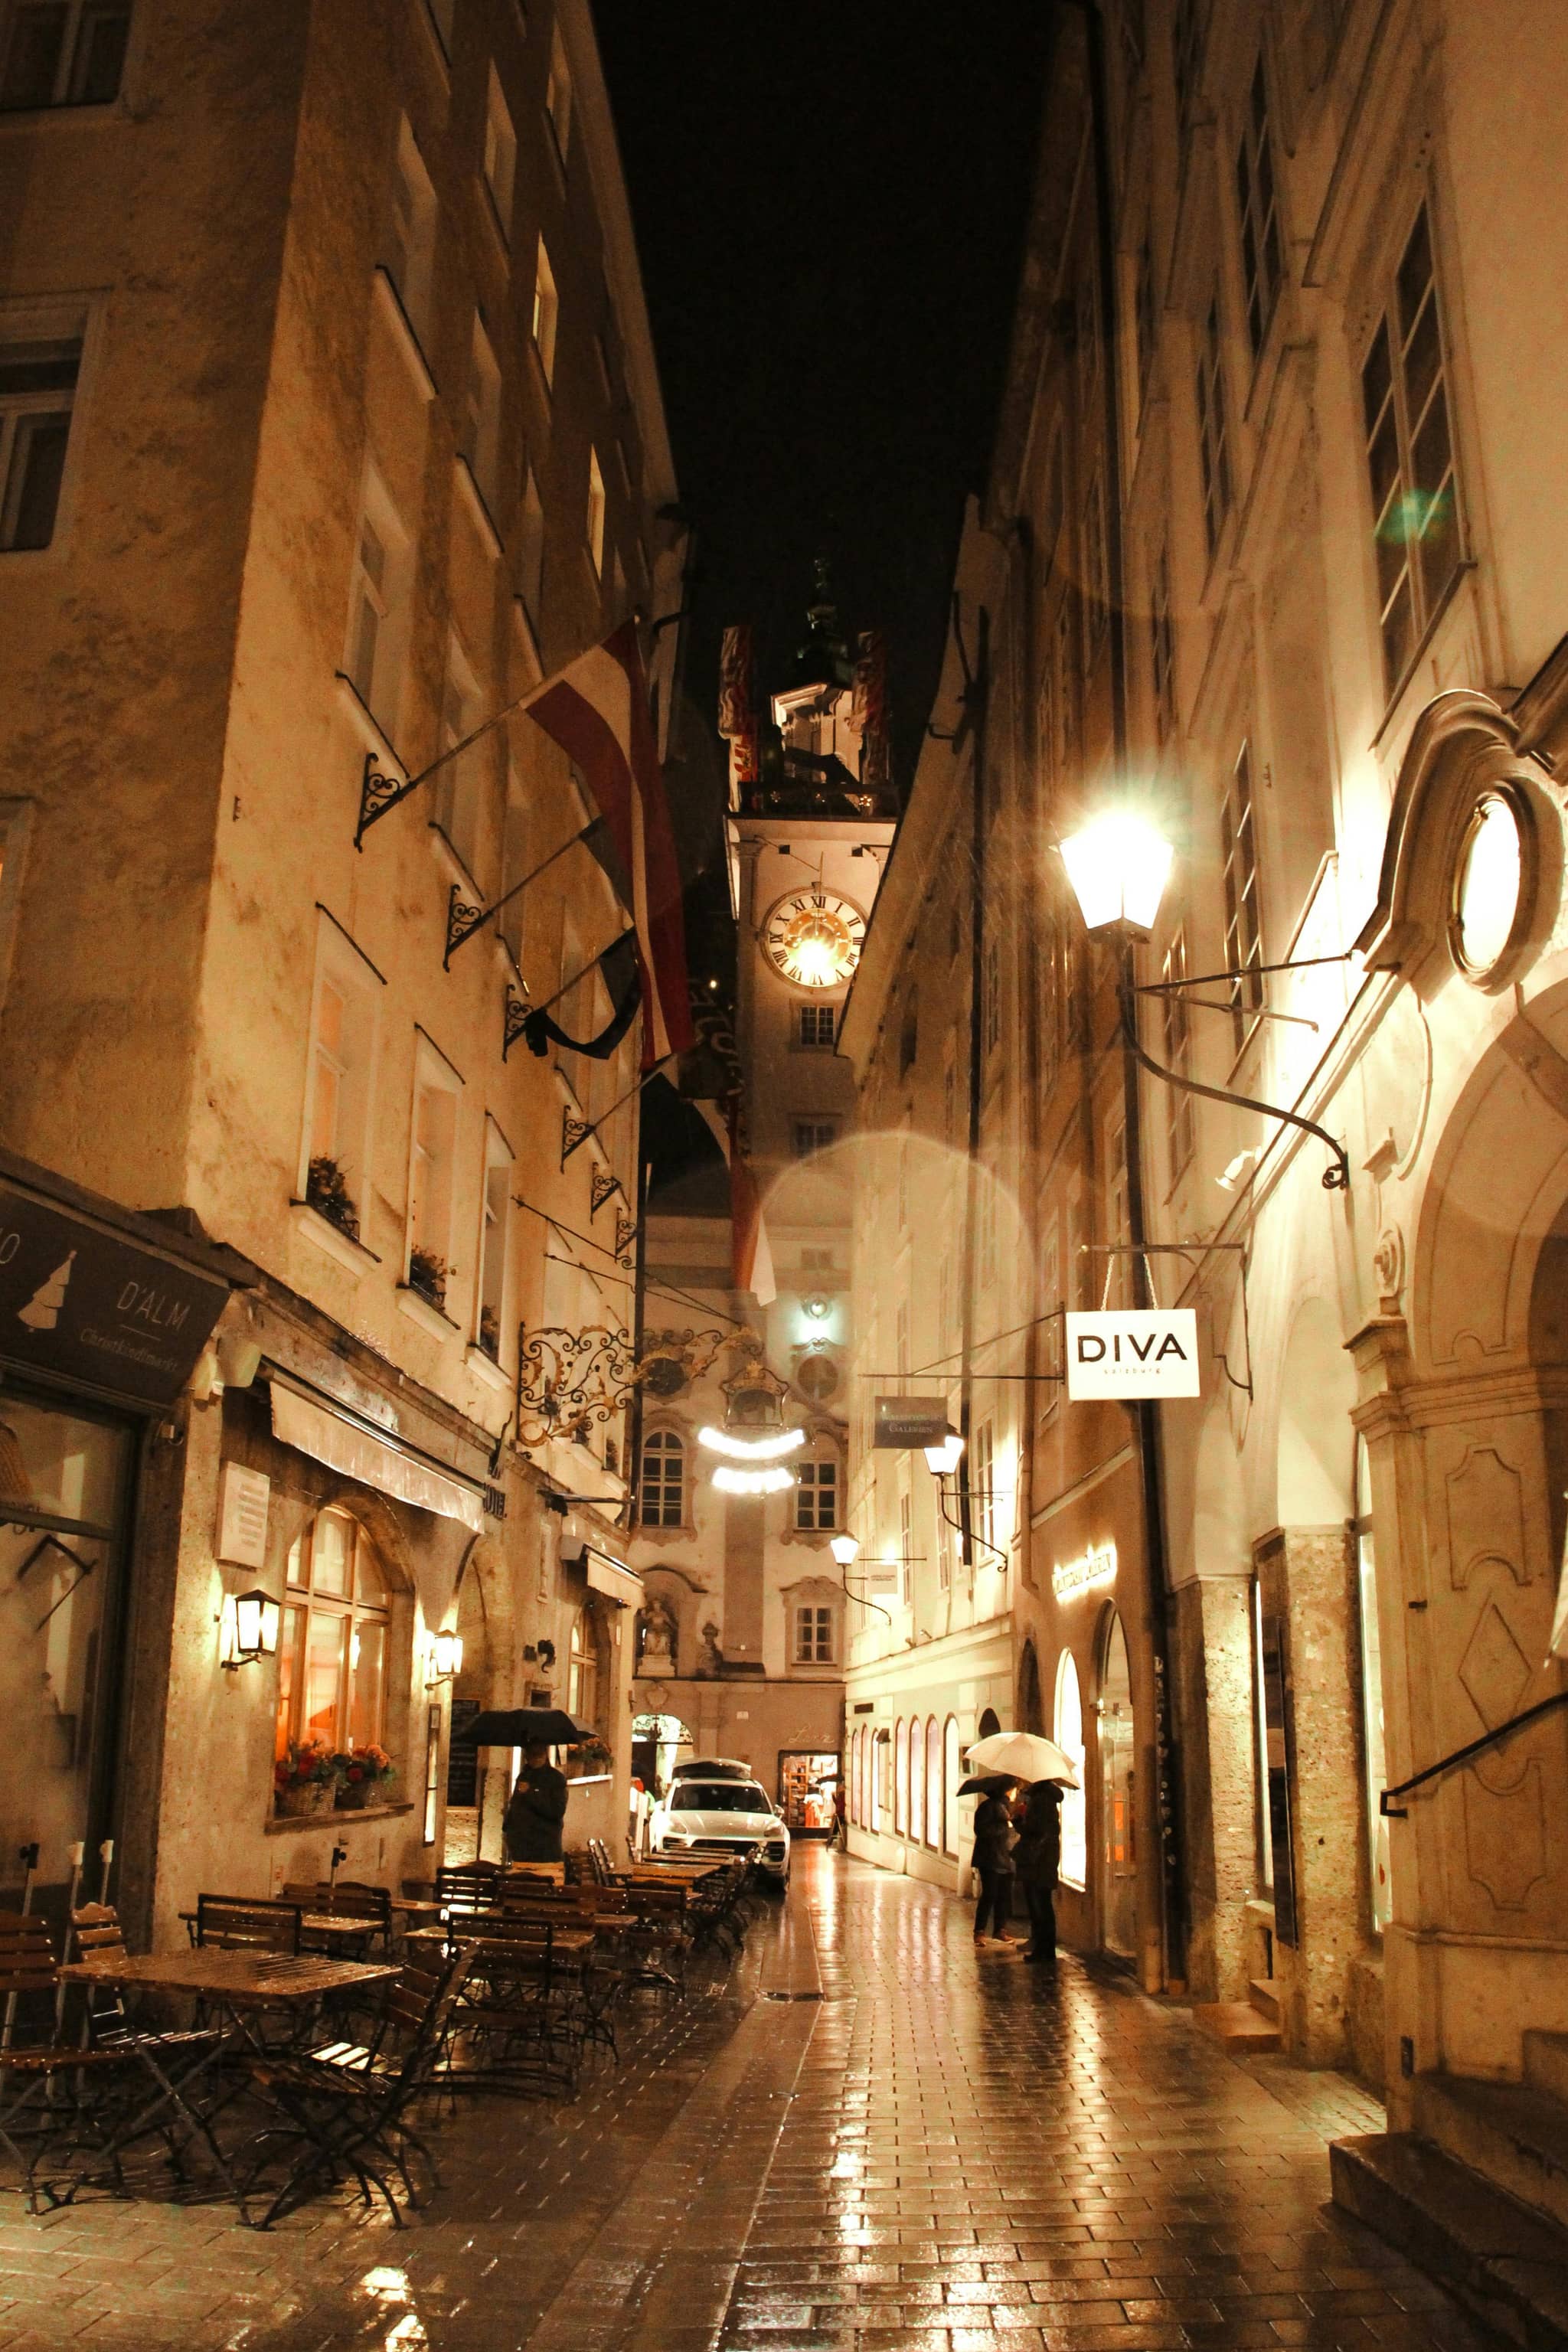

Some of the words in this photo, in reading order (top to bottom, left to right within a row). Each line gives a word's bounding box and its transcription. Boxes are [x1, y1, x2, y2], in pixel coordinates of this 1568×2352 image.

[790, 899, 806, 914] XI
[811, 896, 827, 909] XII
[835, 902, 843, 913] I
[776, 914, 790, 925] X
[847, 917, 861, 927] II
[853, 937, 864, 946] III
[0, 1227, 20, 1263] O
[116, 1281, 191, 1331] D'ALM
[1078, 1333, 1187, 1362] DIVA
